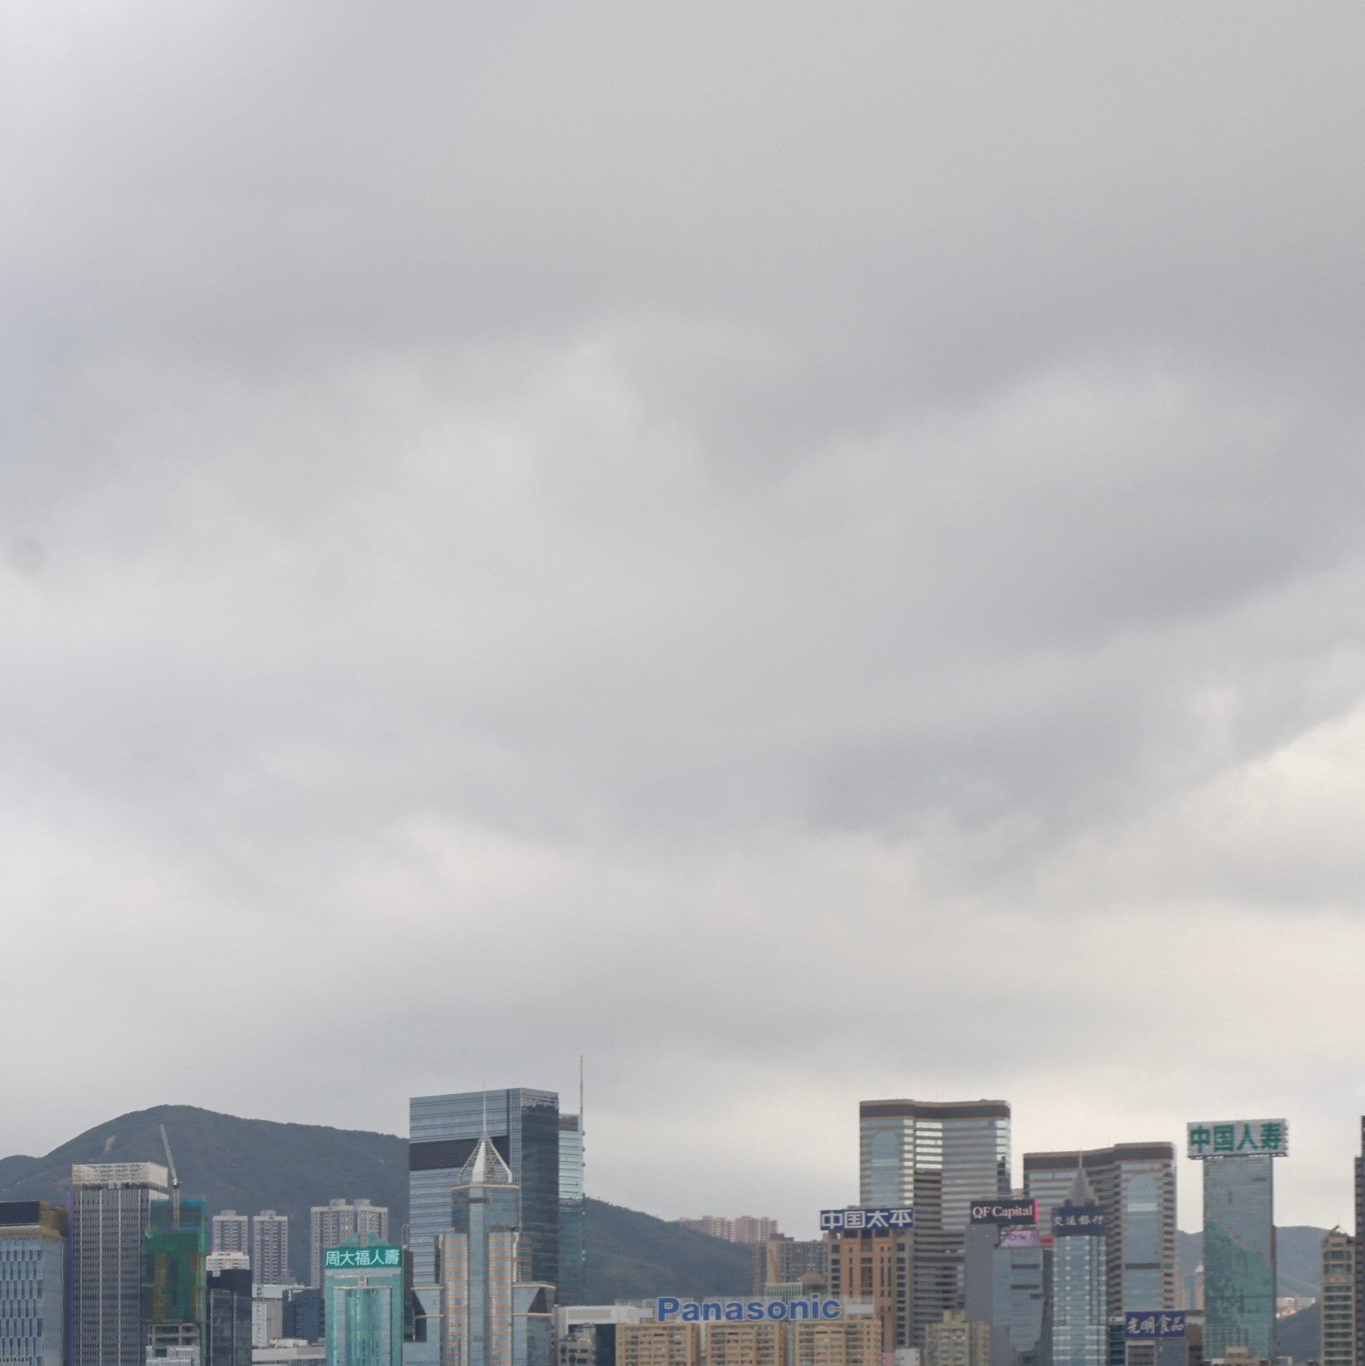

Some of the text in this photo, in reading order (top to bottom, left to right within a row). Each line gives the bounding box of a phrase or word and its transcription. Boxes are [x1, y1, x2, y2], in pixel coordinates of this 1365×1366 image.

[1190, 1123, 1282, 1153] 中国人寿
[821, 1208, 913, 1229] 中国太平
[972, 1205, 1033, 1219] QF Capital
[325, 1249, 400, 1267] 周大福人壽
[657, 1293, 842, 1322] Panasonic
